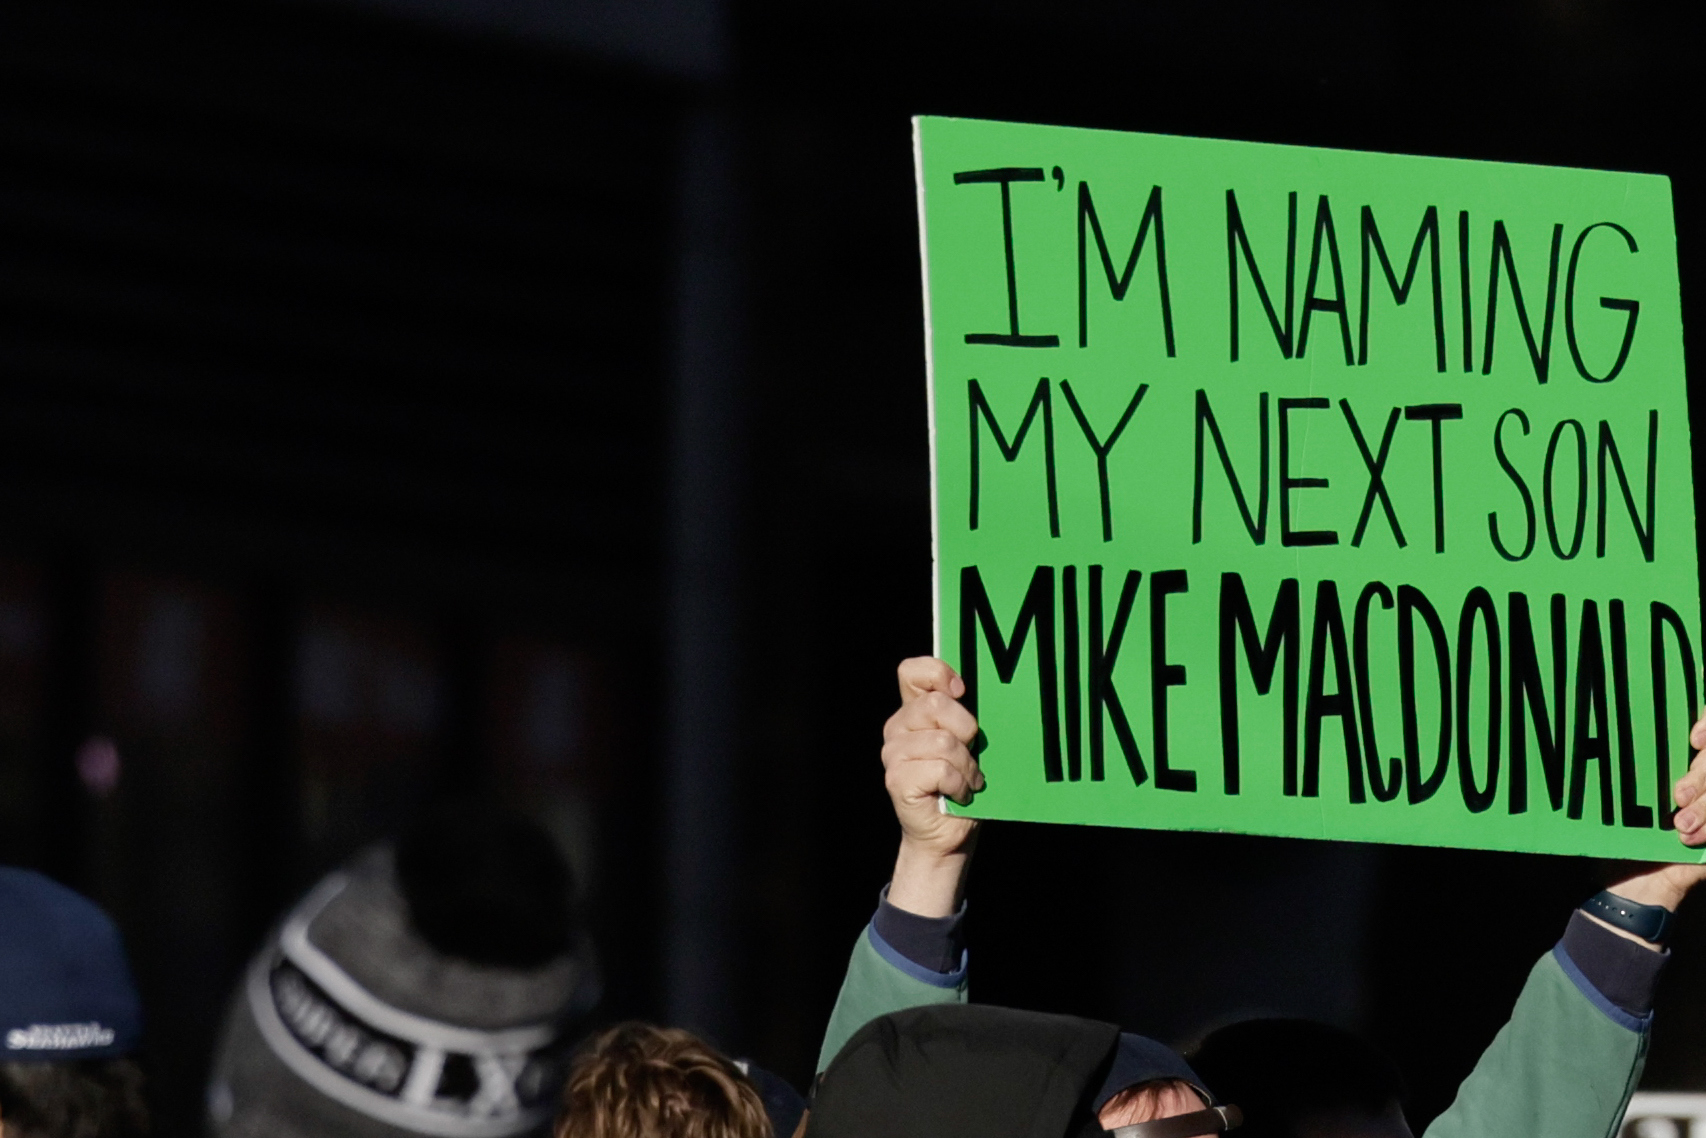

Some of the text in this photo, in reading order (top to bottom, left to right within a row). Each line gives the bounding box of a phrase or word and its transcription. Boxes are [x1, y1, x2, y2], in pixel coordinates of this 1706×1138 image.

[954, 165, 1640, 384] I'M NAMING
[968, 378, 1658, 562] MY NEXT SON
[959, 565, 1698, 831] MIKE MACDONALD
